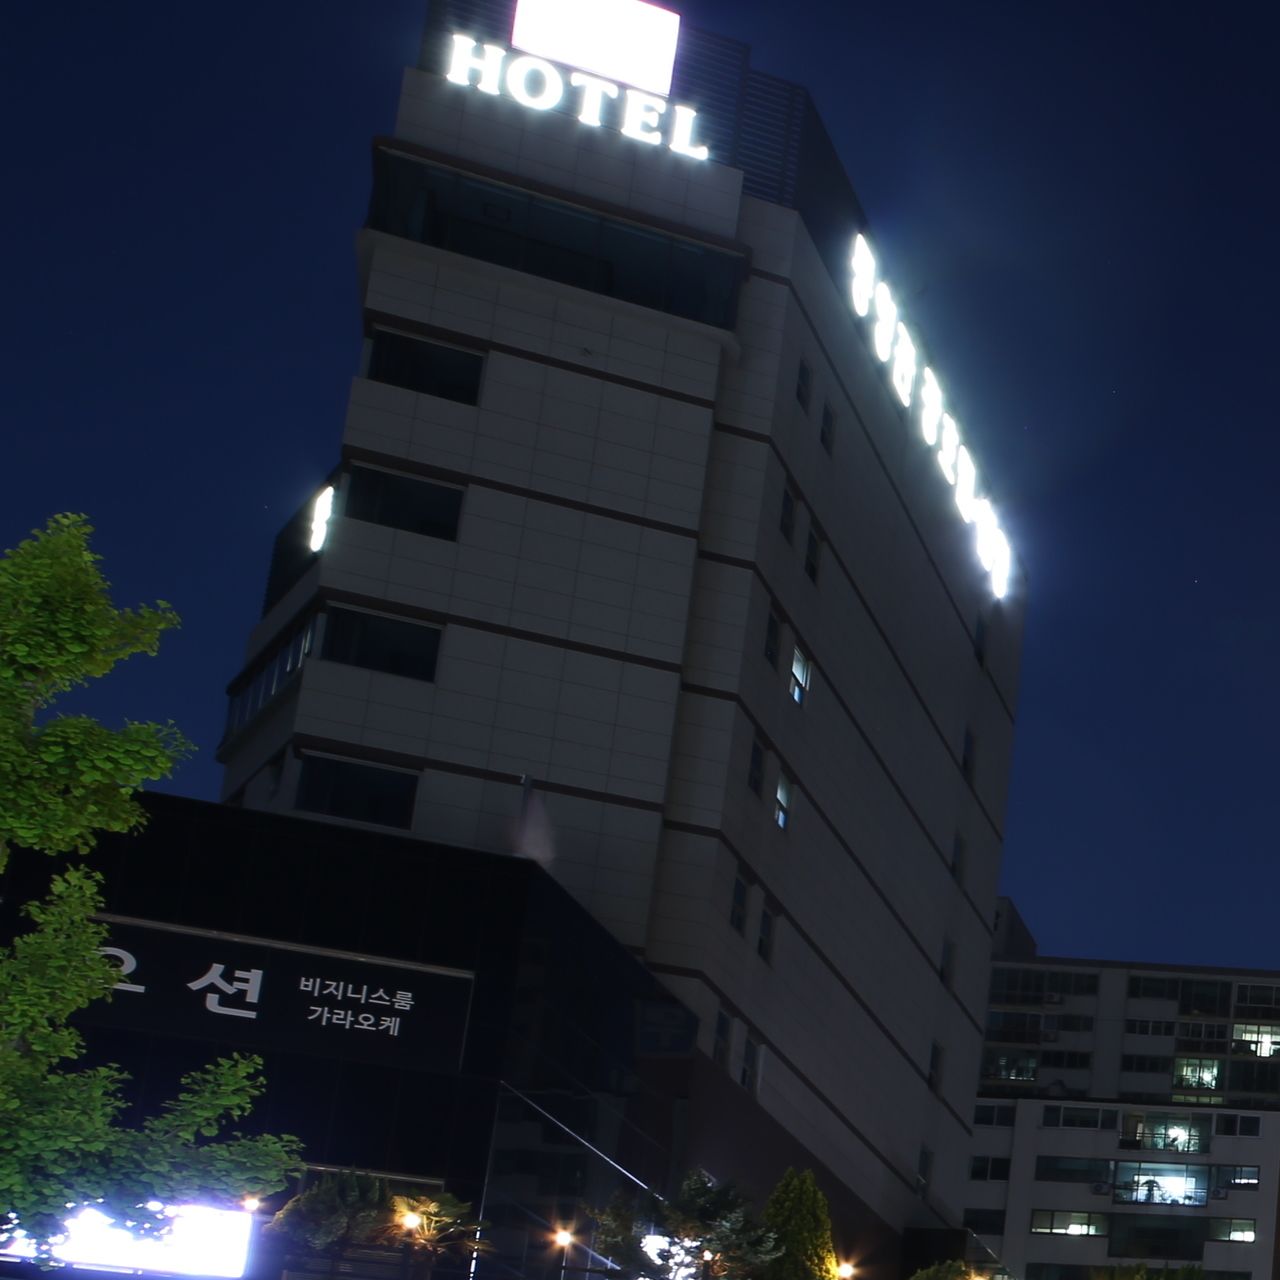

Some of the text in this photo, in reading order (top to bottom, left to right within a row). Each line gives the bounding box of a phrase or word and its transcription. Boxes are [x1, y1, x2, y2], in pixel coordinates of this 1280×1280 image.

[446, 34, 709, 161] HOTEL
[299, 977, 416, 1012] 비지니스룸
[307, 1005, 401, 1037] 가라오케
